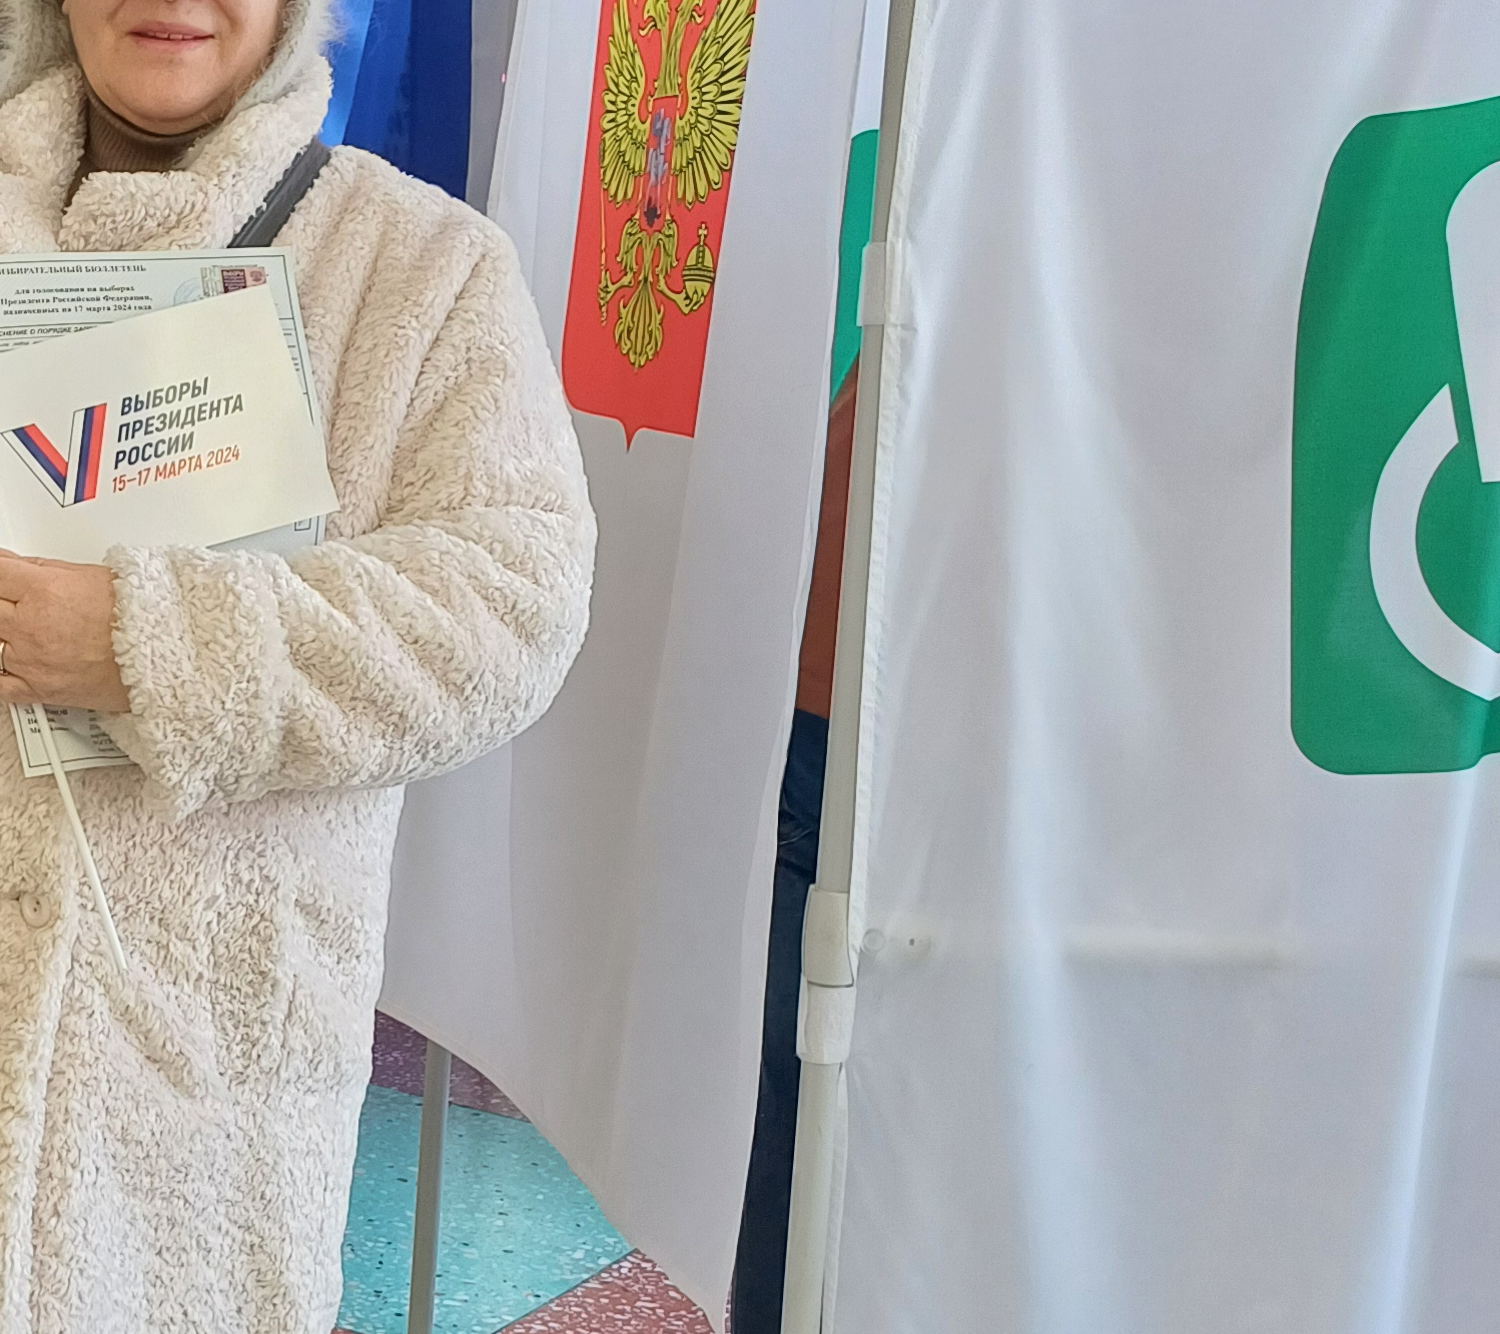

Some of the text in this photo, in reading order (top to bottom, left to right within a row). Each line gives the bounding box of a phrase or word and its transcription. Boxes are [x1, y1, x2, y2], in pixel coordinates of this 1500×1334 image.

[85, 265, 147, 273] БЮЛЛЕТЕНЬ
[74, 305, 83, 313] 17
[112, 304, 132, 312] 2024
[120, 376, 209, 416] ВЫБОРЫ
[117, 394, 244, 443] ПРЕЗИДЕНТА
[114, 431, 195, 470] РОССИИ
[154, 454, 203, 482] МАРТА
[206, 444, 240, 468] 2024
